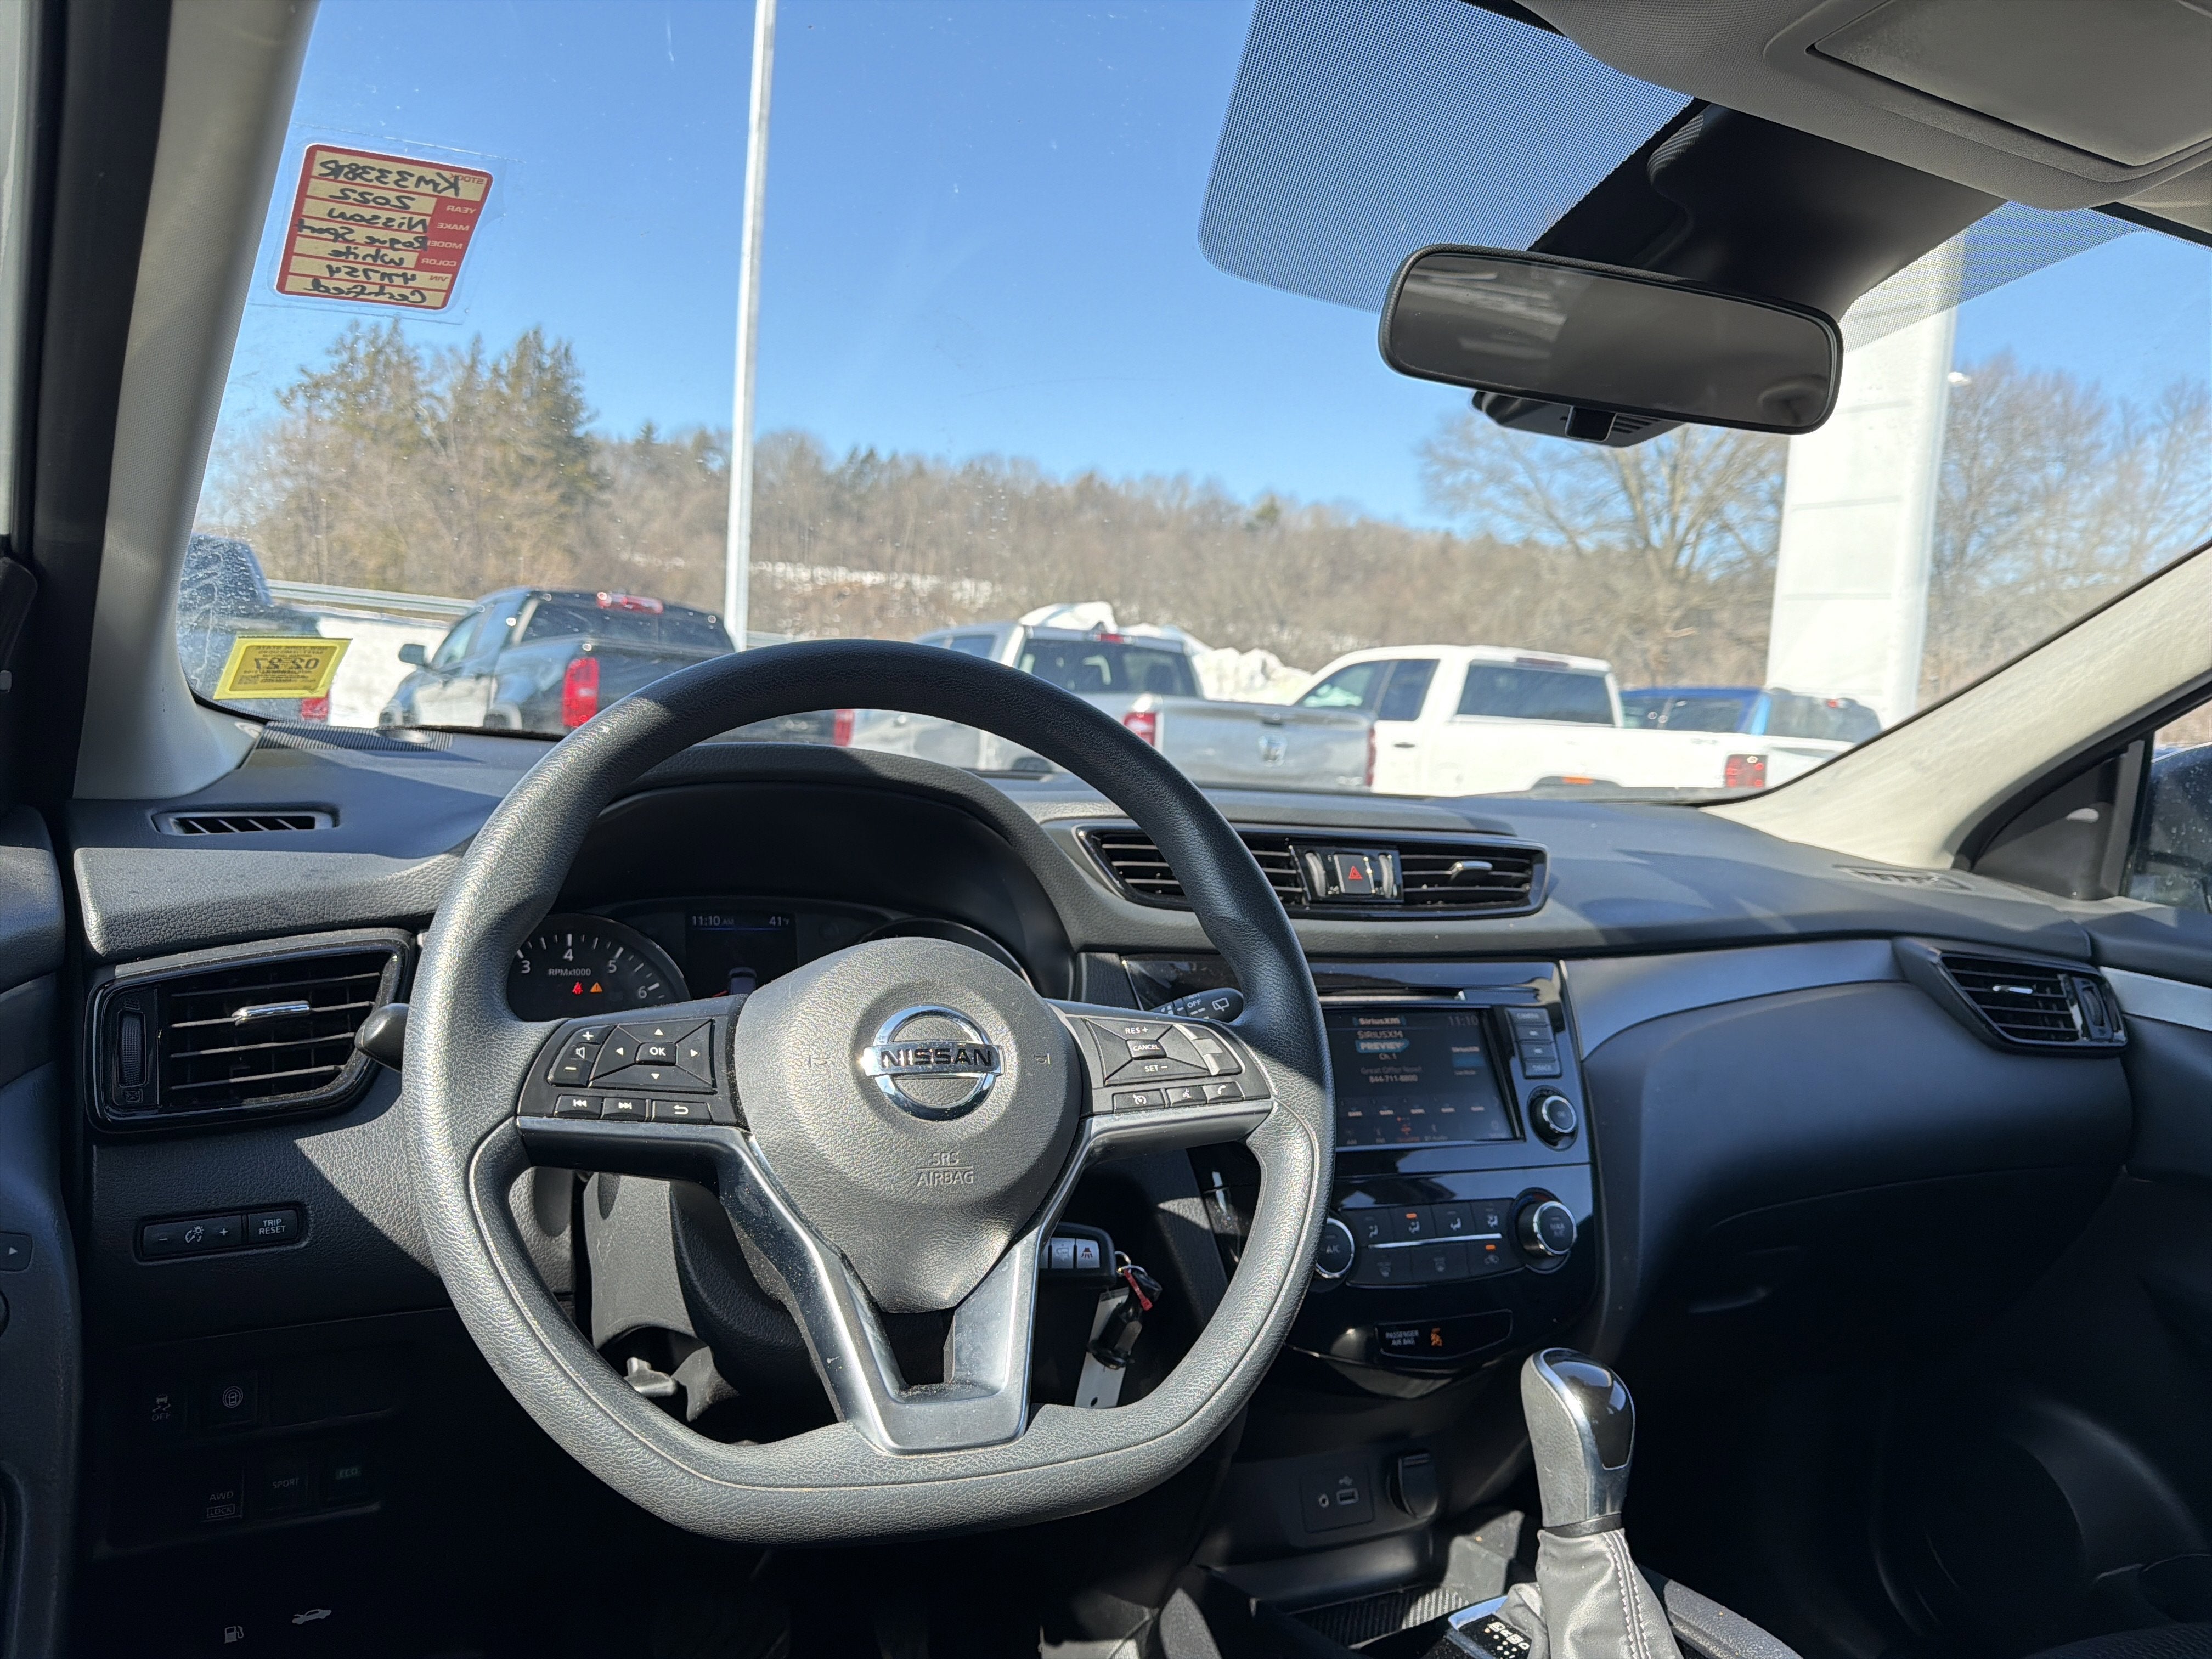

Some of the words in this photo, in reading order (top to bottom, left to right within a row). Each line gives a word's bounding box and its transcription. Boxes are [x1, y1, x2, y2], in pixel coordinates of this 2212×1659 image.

[691, 915, 721, 926] 11:10
[563, 949, 574, 962] 4
[521, 960, 531, 974] 3
[607, 960, 618, 973] 5
[548, 967, 592, 978] RPMx1000
[637, 986, 648, 1000] 6
[1187, 998, 1202, 1008] OFF
[1448, 1014, 1479, 1026] 11:10
[650, 1047, 667, 1056] OK
[1133, 1043, 1160, 1052] CANCEL
[881, 1047, 992, 1068] NISSAN
[1144, 1064, 1159, 1073] SET
[931, 1152, 961, 1164] SRS
[917, 1171, 974, 1187] AIRBAG
[262, 1218, 282, 1227] TRIP
[259, 1225, 287, 1235] RESET
[151, 1412, 172, 1422] OFF
[338, 1468, 359, 1479] ECO
[272, 1477, 300, 1489] SPORT
[209, 1490, 234, 1502] AWD
[210, 1506, 233, 1516] LOCK
